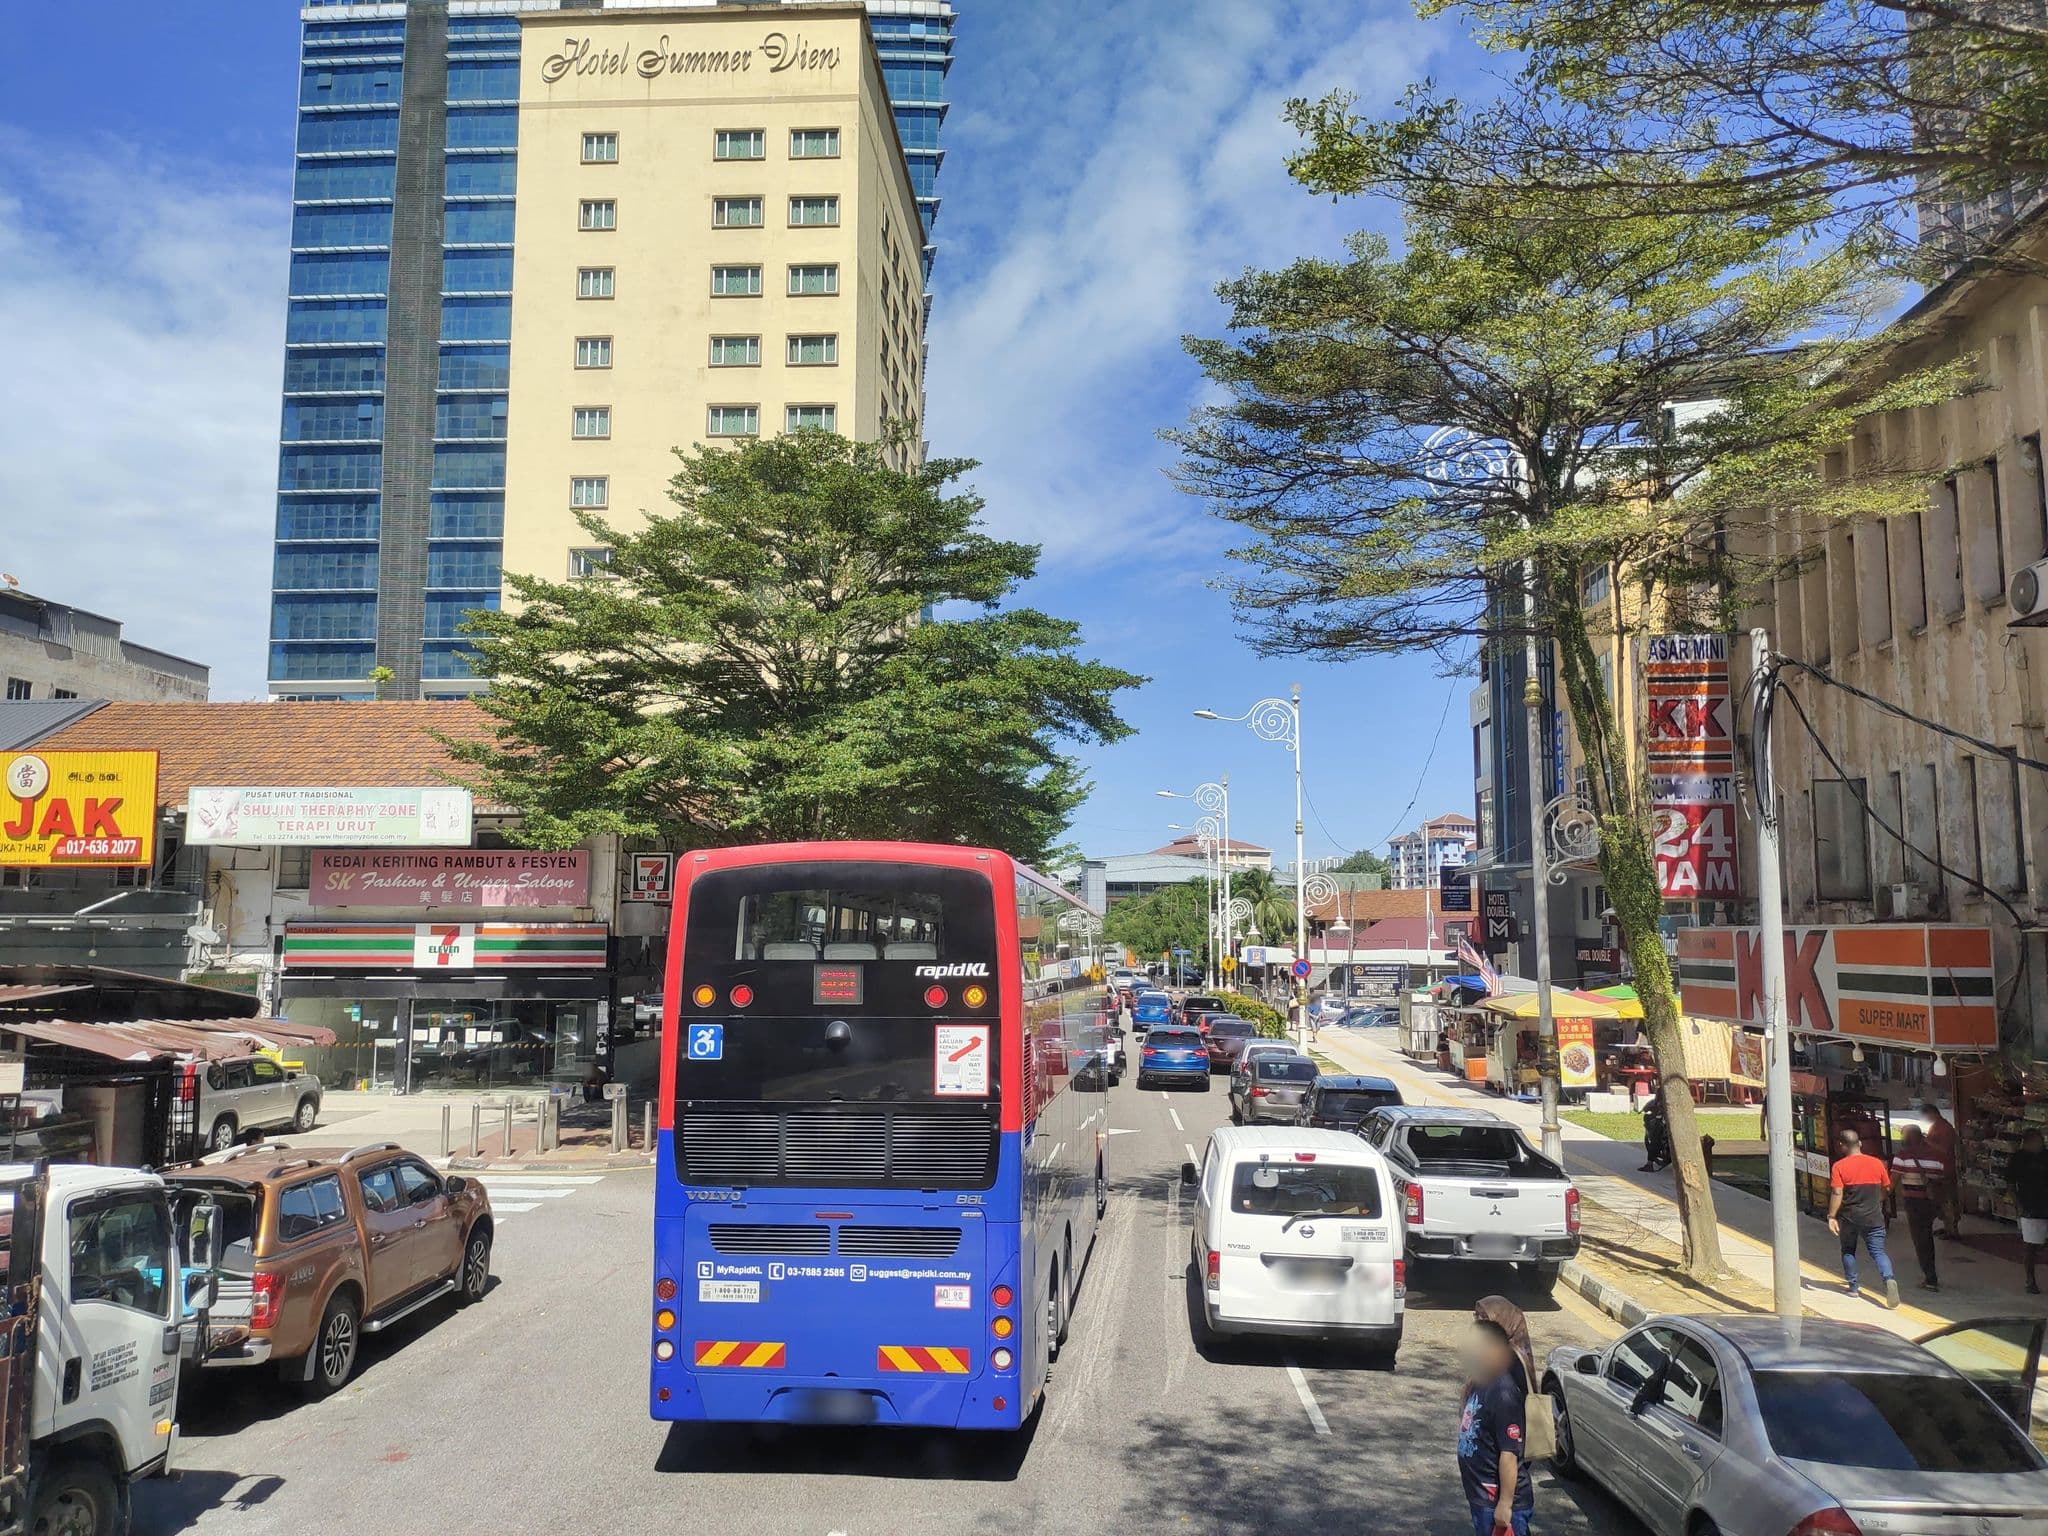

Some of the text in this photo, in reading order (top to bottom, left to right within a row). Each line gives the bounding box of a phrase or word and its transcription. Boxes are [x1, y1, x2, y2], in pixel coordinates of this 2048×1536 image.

[542, 37, 629, 84] Hotel
[637, 34, 752, 79] Summer
[1693, 638, 1724, 659] MINI
[1649, 698, 1727, 737] KK
[245, 791, 354, 799] PUSAT URUT TRADISIONAL
[243, 804, 416, 817] SHUJIN THERAPHY ZONE
[277, 821, 376, 832] TERAPI URUT
[1653, 808, 1733, 858] 24
[25, 844, 46, 852] HARI
[66, 839, 109, 855] 017-636
[111, 839, 137, 855] 2077
[323, 856, 577, 868] KEDAI KERITING RAMBUT & FESYEN
[325, 872, 357, 891] SK
[361, 872, 428, 888] Fashion
[431, 873, 445, 887] &
[516, 873, 575, 888] Saloon
[640, 860, 664, 890] 7
[1488, 894, 1507, 905] HOTEL
[1486, 906, 1509, 917] DOUBLE
[431, 926, 460, 965] 7
[915, 963, 990, 979] rapidKL
[1859, 1009, 1926, 1031] SUPER MART
[685, 1190, 741, 1201] VOLVO
[717, 1265, 762, 1275] MyRapidKL
[787, 1267, 844, 1277] 03-7885 2585
[869, 1269, 971, 1280] suggest@rapidkl.com.my
